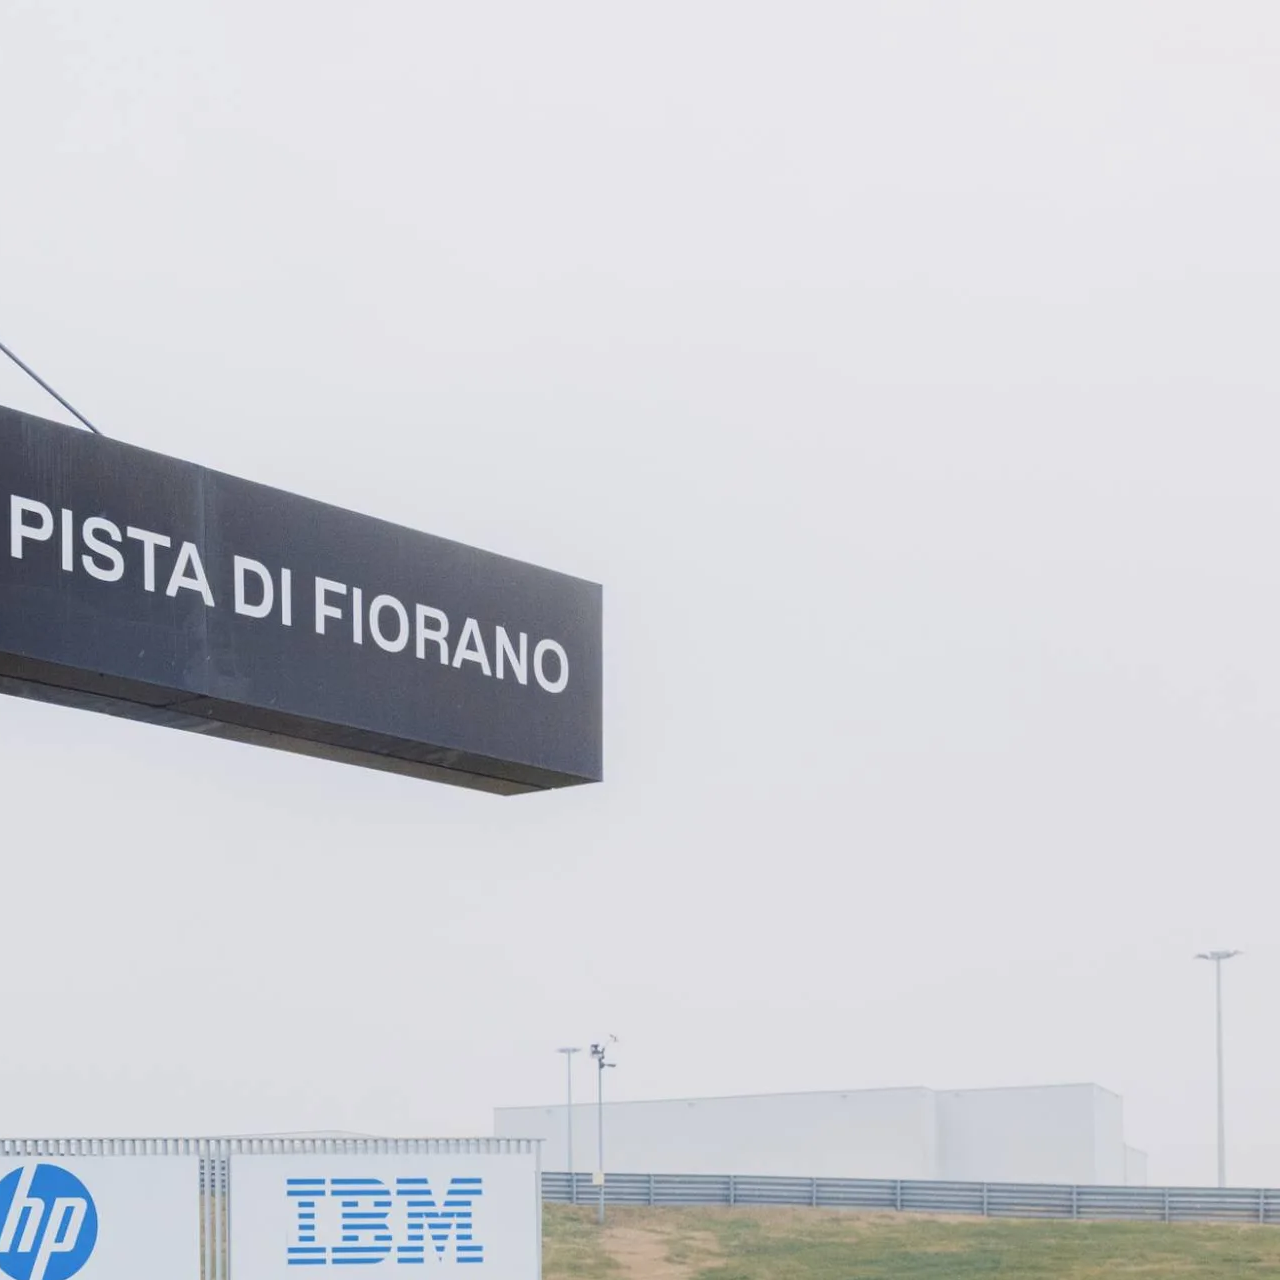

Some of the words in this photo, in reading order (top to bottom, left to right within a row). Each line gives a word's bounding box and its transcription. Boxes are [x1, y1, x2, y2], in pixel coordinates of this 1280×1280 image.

[9, 493, 215, 608] PISTA
[234, 554, 293, 627] DI
[315, 581, 570, 694] FIORANO
[286, 1177, 484, 1265] IBM
